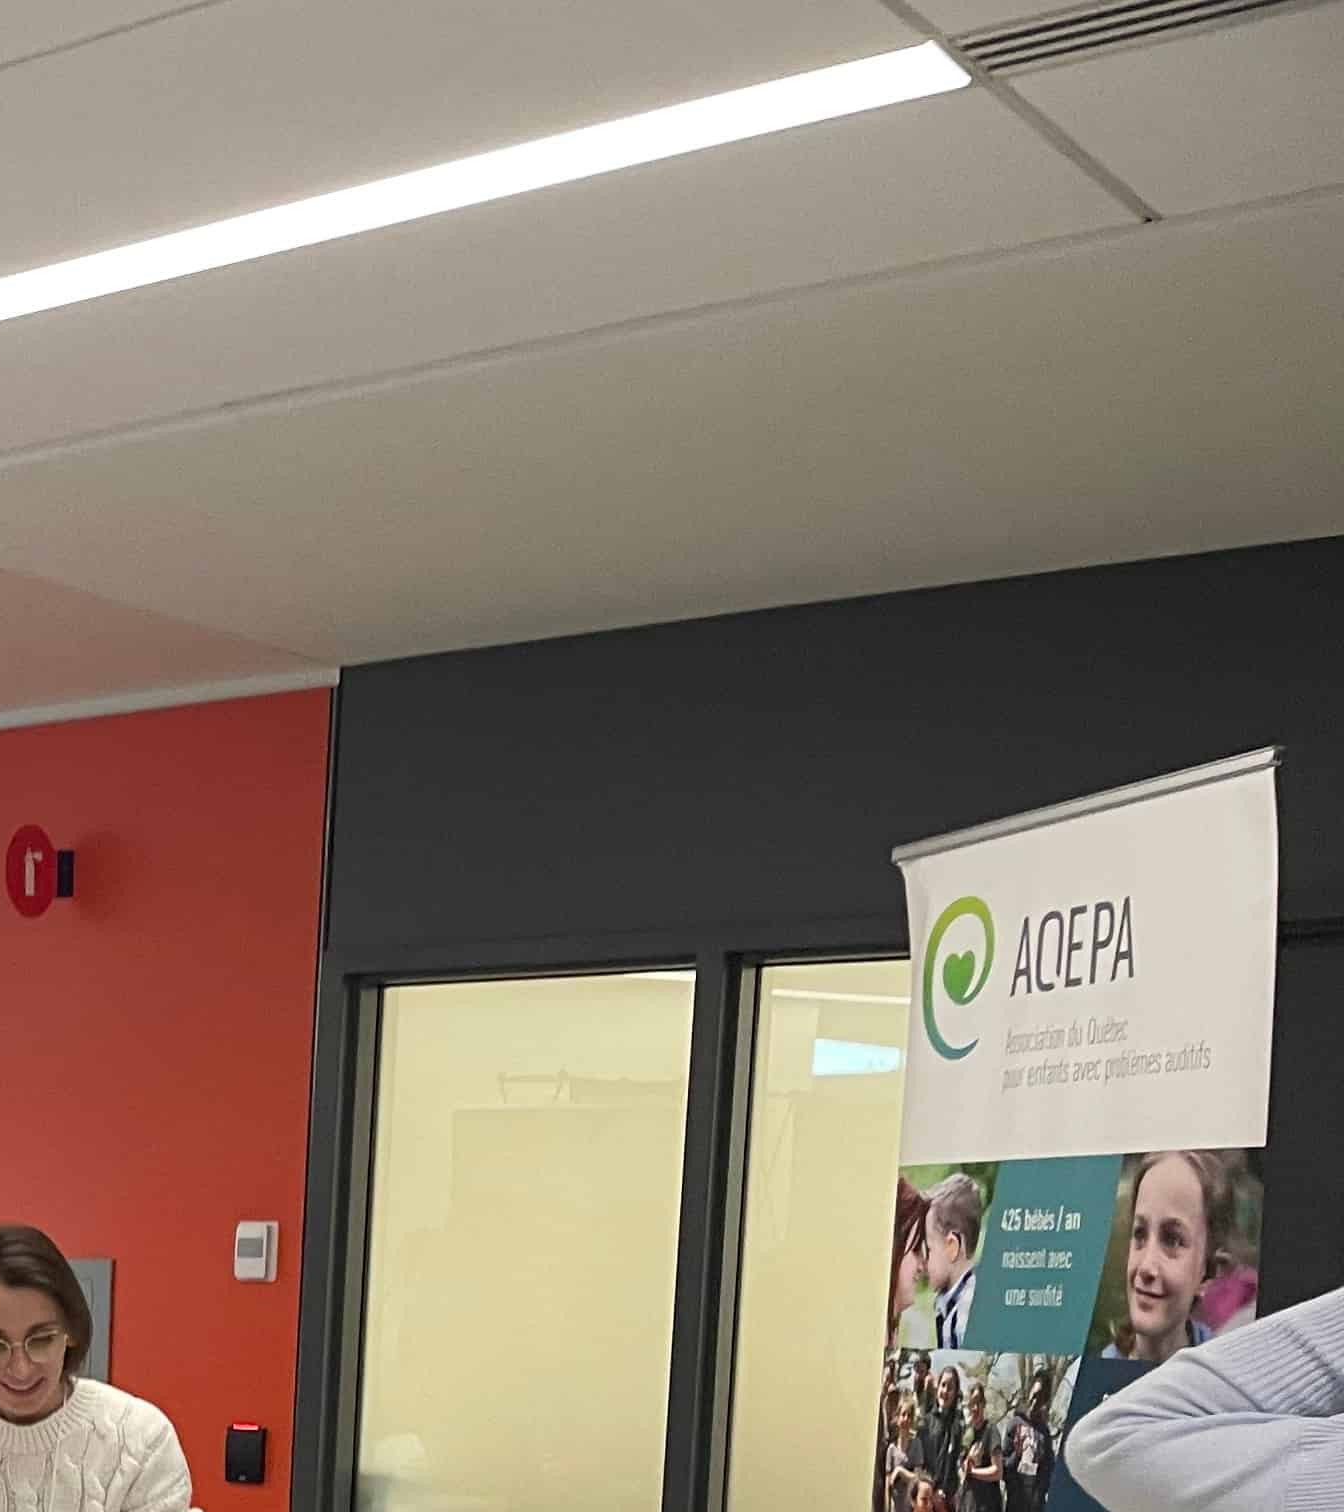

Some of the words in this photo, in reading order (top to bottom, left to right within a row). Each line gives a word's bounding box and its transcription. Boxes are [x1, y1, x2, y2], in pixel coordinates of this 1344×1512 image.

[1010, 896, 1135, 998] AQEPA
[1004, 1026, 1064, 1056] Association
[1067, 1020, 1082, 1048] du
[1087, 1016, 1129, 1046] Québec
[1026, 1057, 1069, 1088] enfants
[1072, 1057, 1102, 1082] avec
[1104, 1050, 1162, 1086] problèmes
[1164, 1040, 1212, 1072] auditifs
[1001, 1207, 1022, 1231] 425
[1024, 1206, 1055, 1232] bébés
[1065, 1211, 1082, 1231] an
[1001, 1247, 1047, 1269] naissent
[1048, 1250, 1073, 1269] avec
[1004, 1287, 1026, 1306] une
